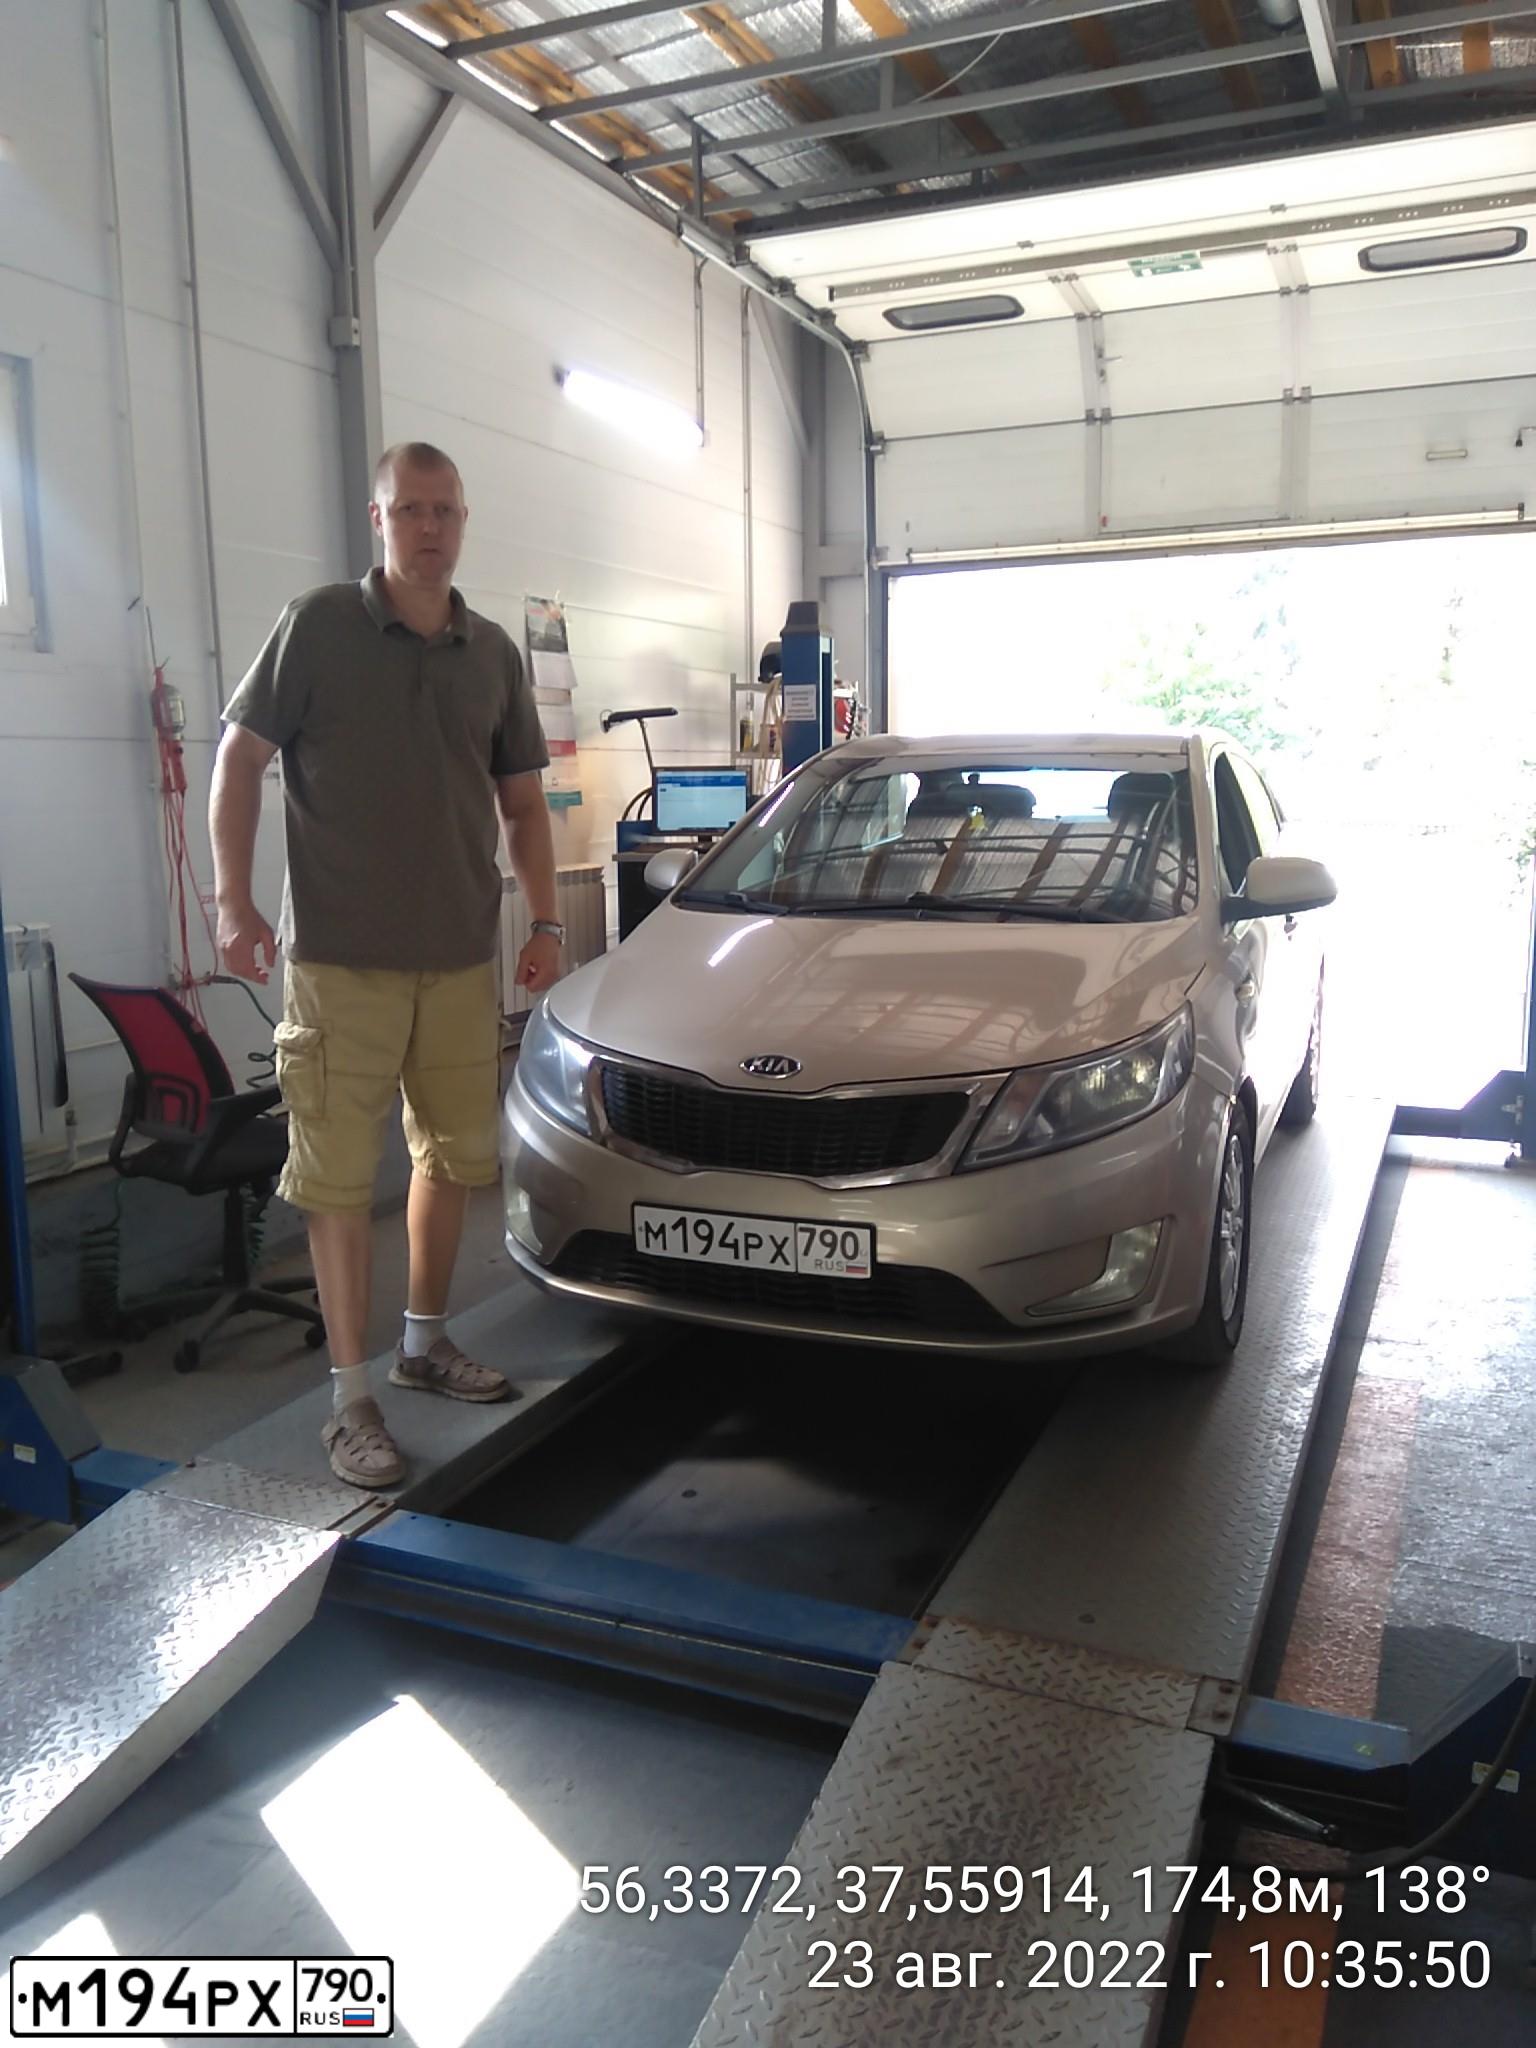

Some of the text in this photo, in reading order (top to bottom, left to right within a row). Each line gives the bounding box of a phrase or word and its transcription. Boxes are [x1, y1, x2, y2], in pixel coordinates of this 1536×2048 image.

[749, 1056, 789, 1073] KIA
[798, 1226, 860, 1261] 790
[813, 1258, 845, 1272] RUS
